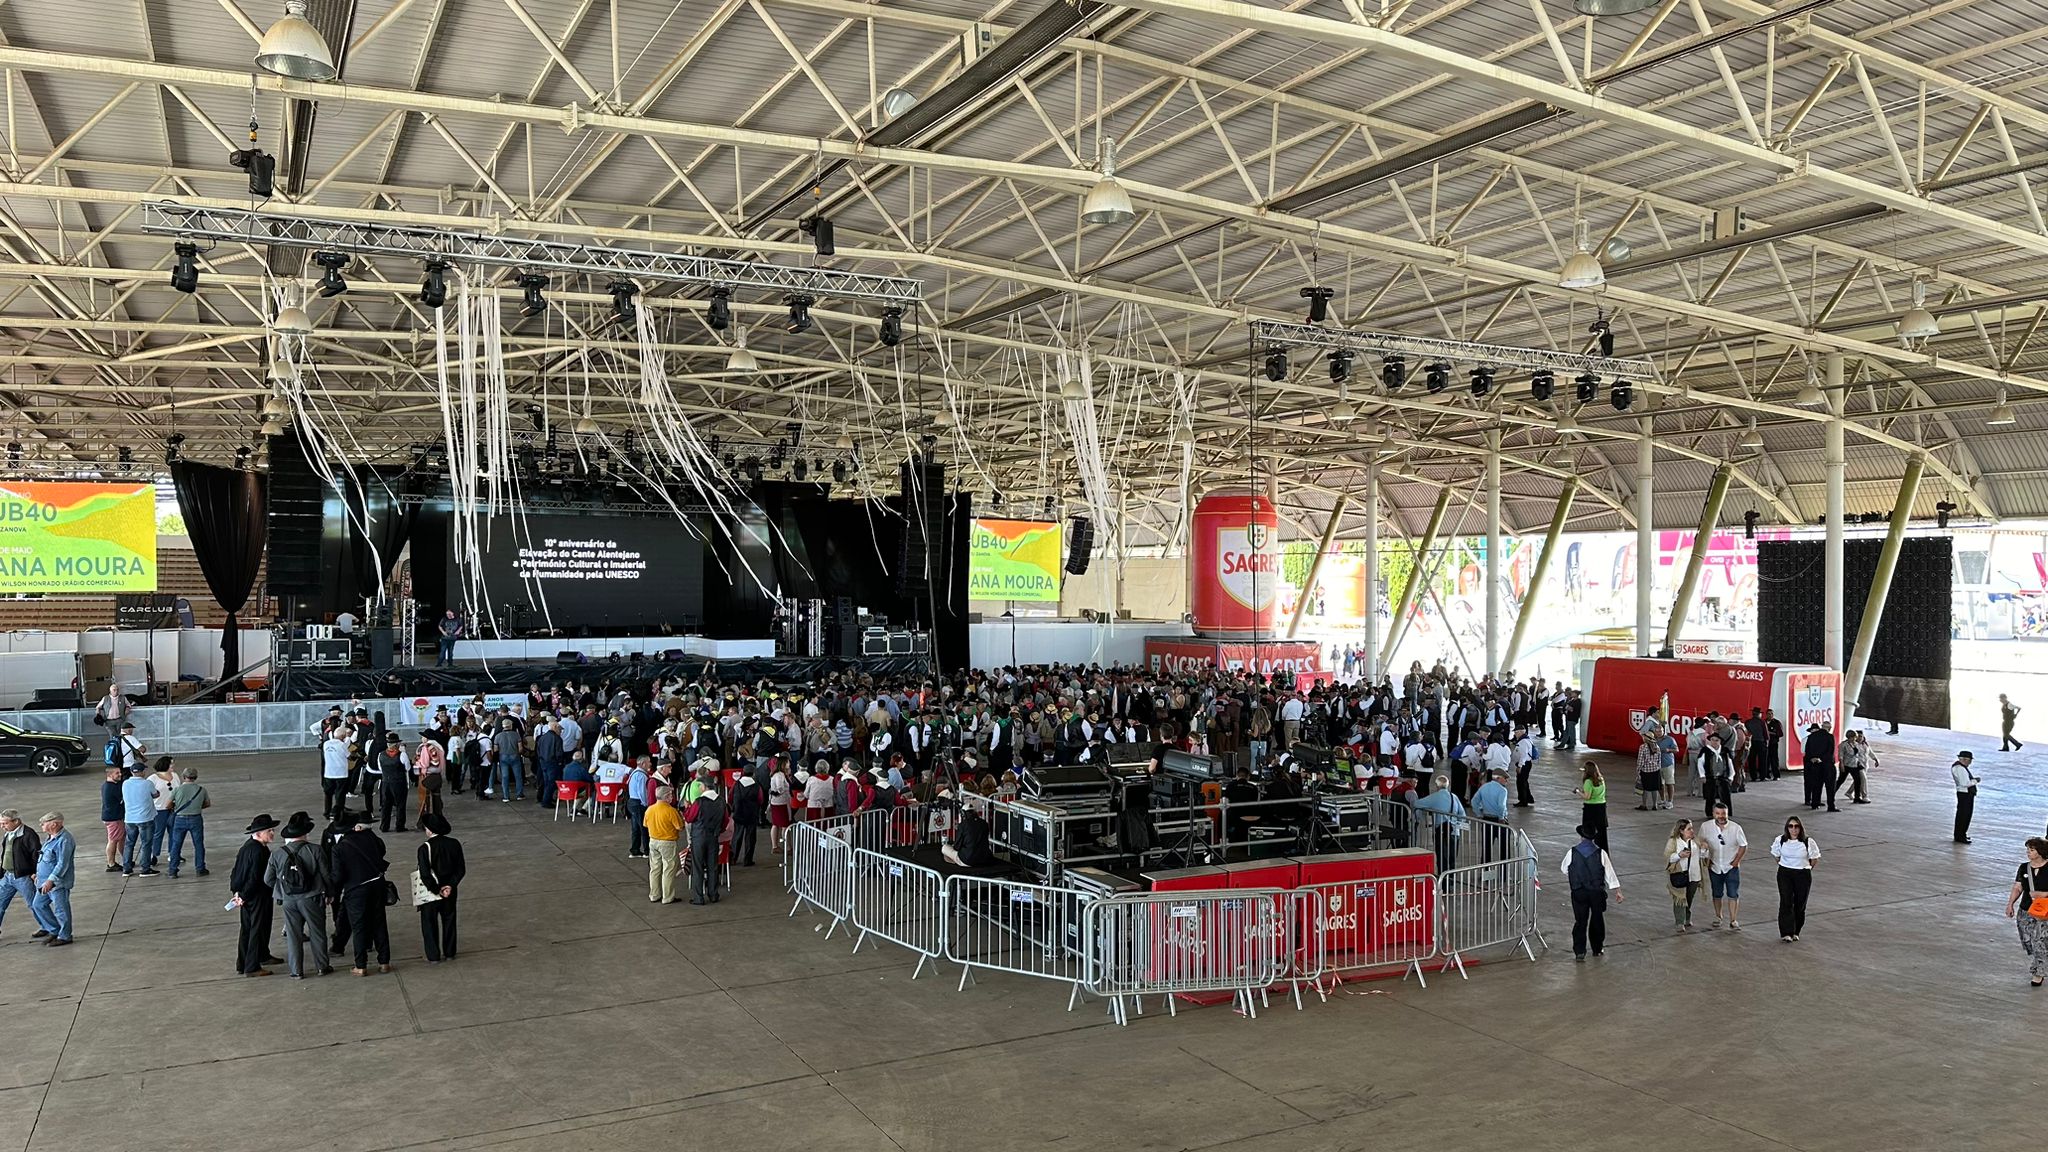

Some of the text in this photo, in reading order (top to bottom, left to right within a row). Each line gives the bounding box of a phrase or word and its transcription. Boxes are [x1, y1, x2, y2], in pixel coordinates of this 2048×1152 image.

[558, 538, 605, 549] aniversário
[606, 540, 617, 549] da
[971, 534, 1008, 549] UB40
[519, 548, 640, 560] Elevação do Cante Alentejano
[55, 556, 145, 576] MOURA
[520, 559, 567, 569] Património
[568, 559, 602, 569] Cultural
[602, 561, 609, 569] e
[532, 569, 585, 579] Humanidade
[585, 570, 604, 580] pela
[604, 570, 640, 579] UNESCO
[970, 574, 1054, 590] ANA MOURA
[1683, 645, 1709, 655] SAGRES
[1724, 645, 1744, 655] SAGRES
[1736, 669, 1764, 681] SAGRES
[1797, 707, 1832, 727] SAGRES
[1384, 904, 1423, 928] SAGRES
[1315, 913, 1357, 934] SAGRES
